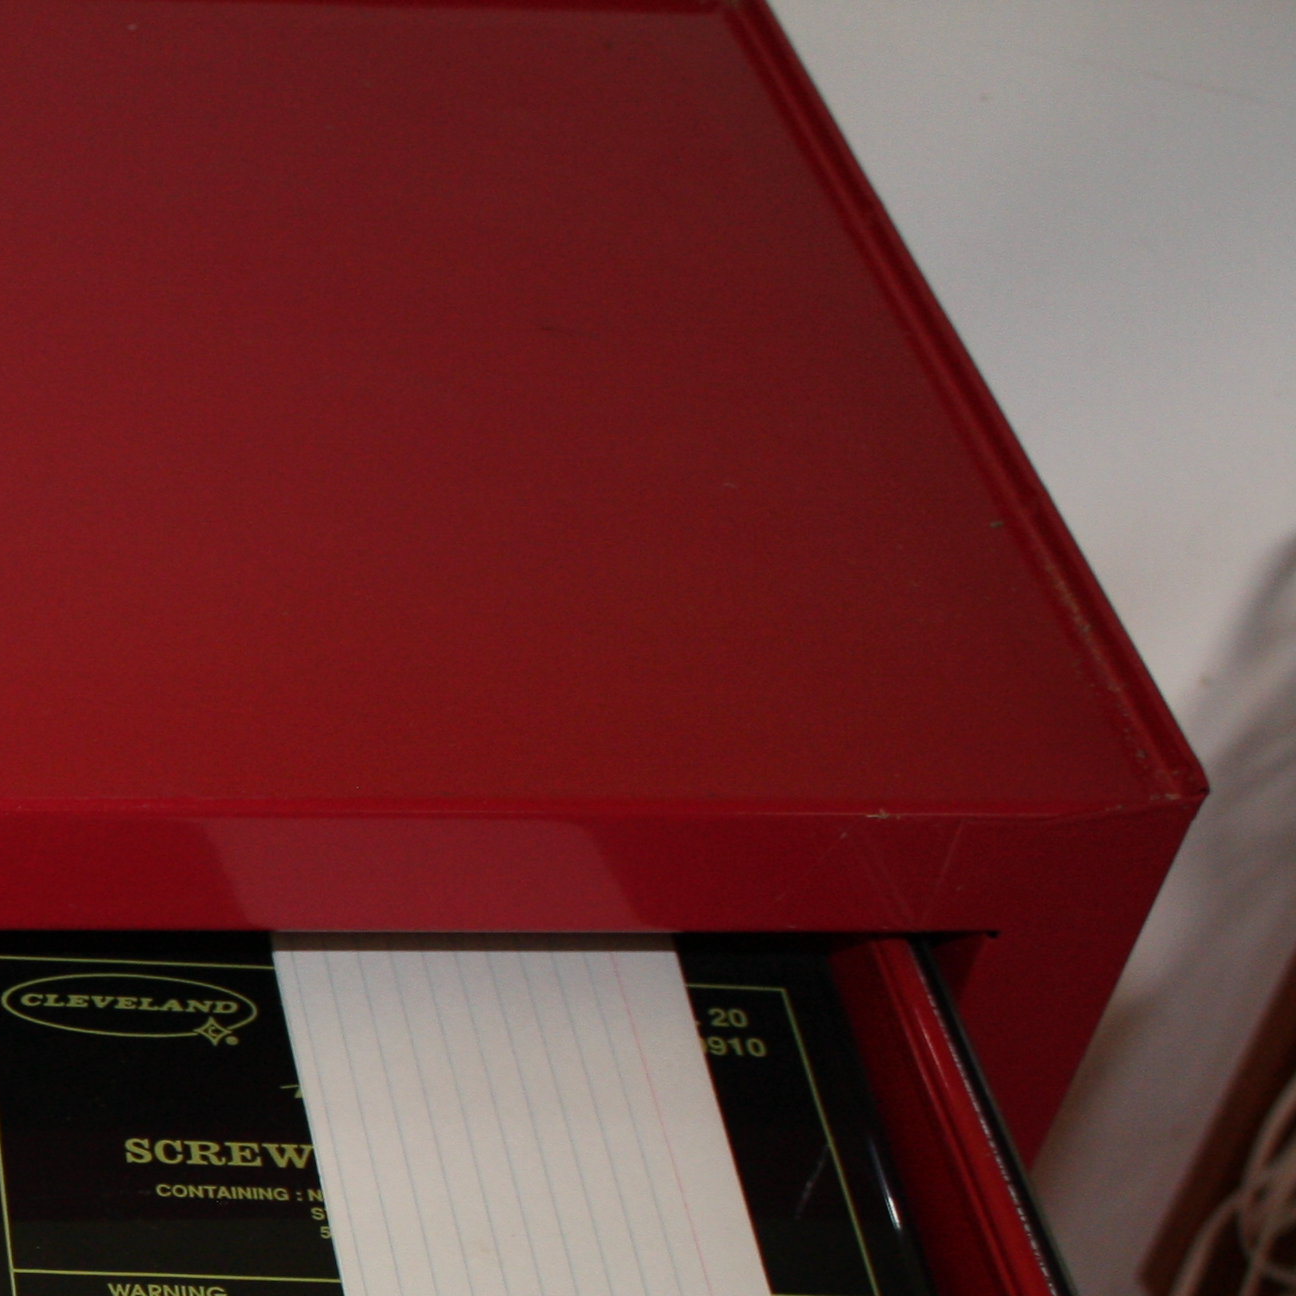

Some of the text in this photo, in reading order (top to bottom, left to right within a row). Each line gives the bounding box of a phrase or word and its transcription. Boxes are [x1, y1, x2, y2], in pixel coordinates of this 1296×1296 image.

[20, 993, 238, 1014] CLEVELAND
[708, 1007, 748, 1028] 20
[125, 1138, 314, 1169] SCREW
[155, 1183, 289, 1201] CONTAINING
